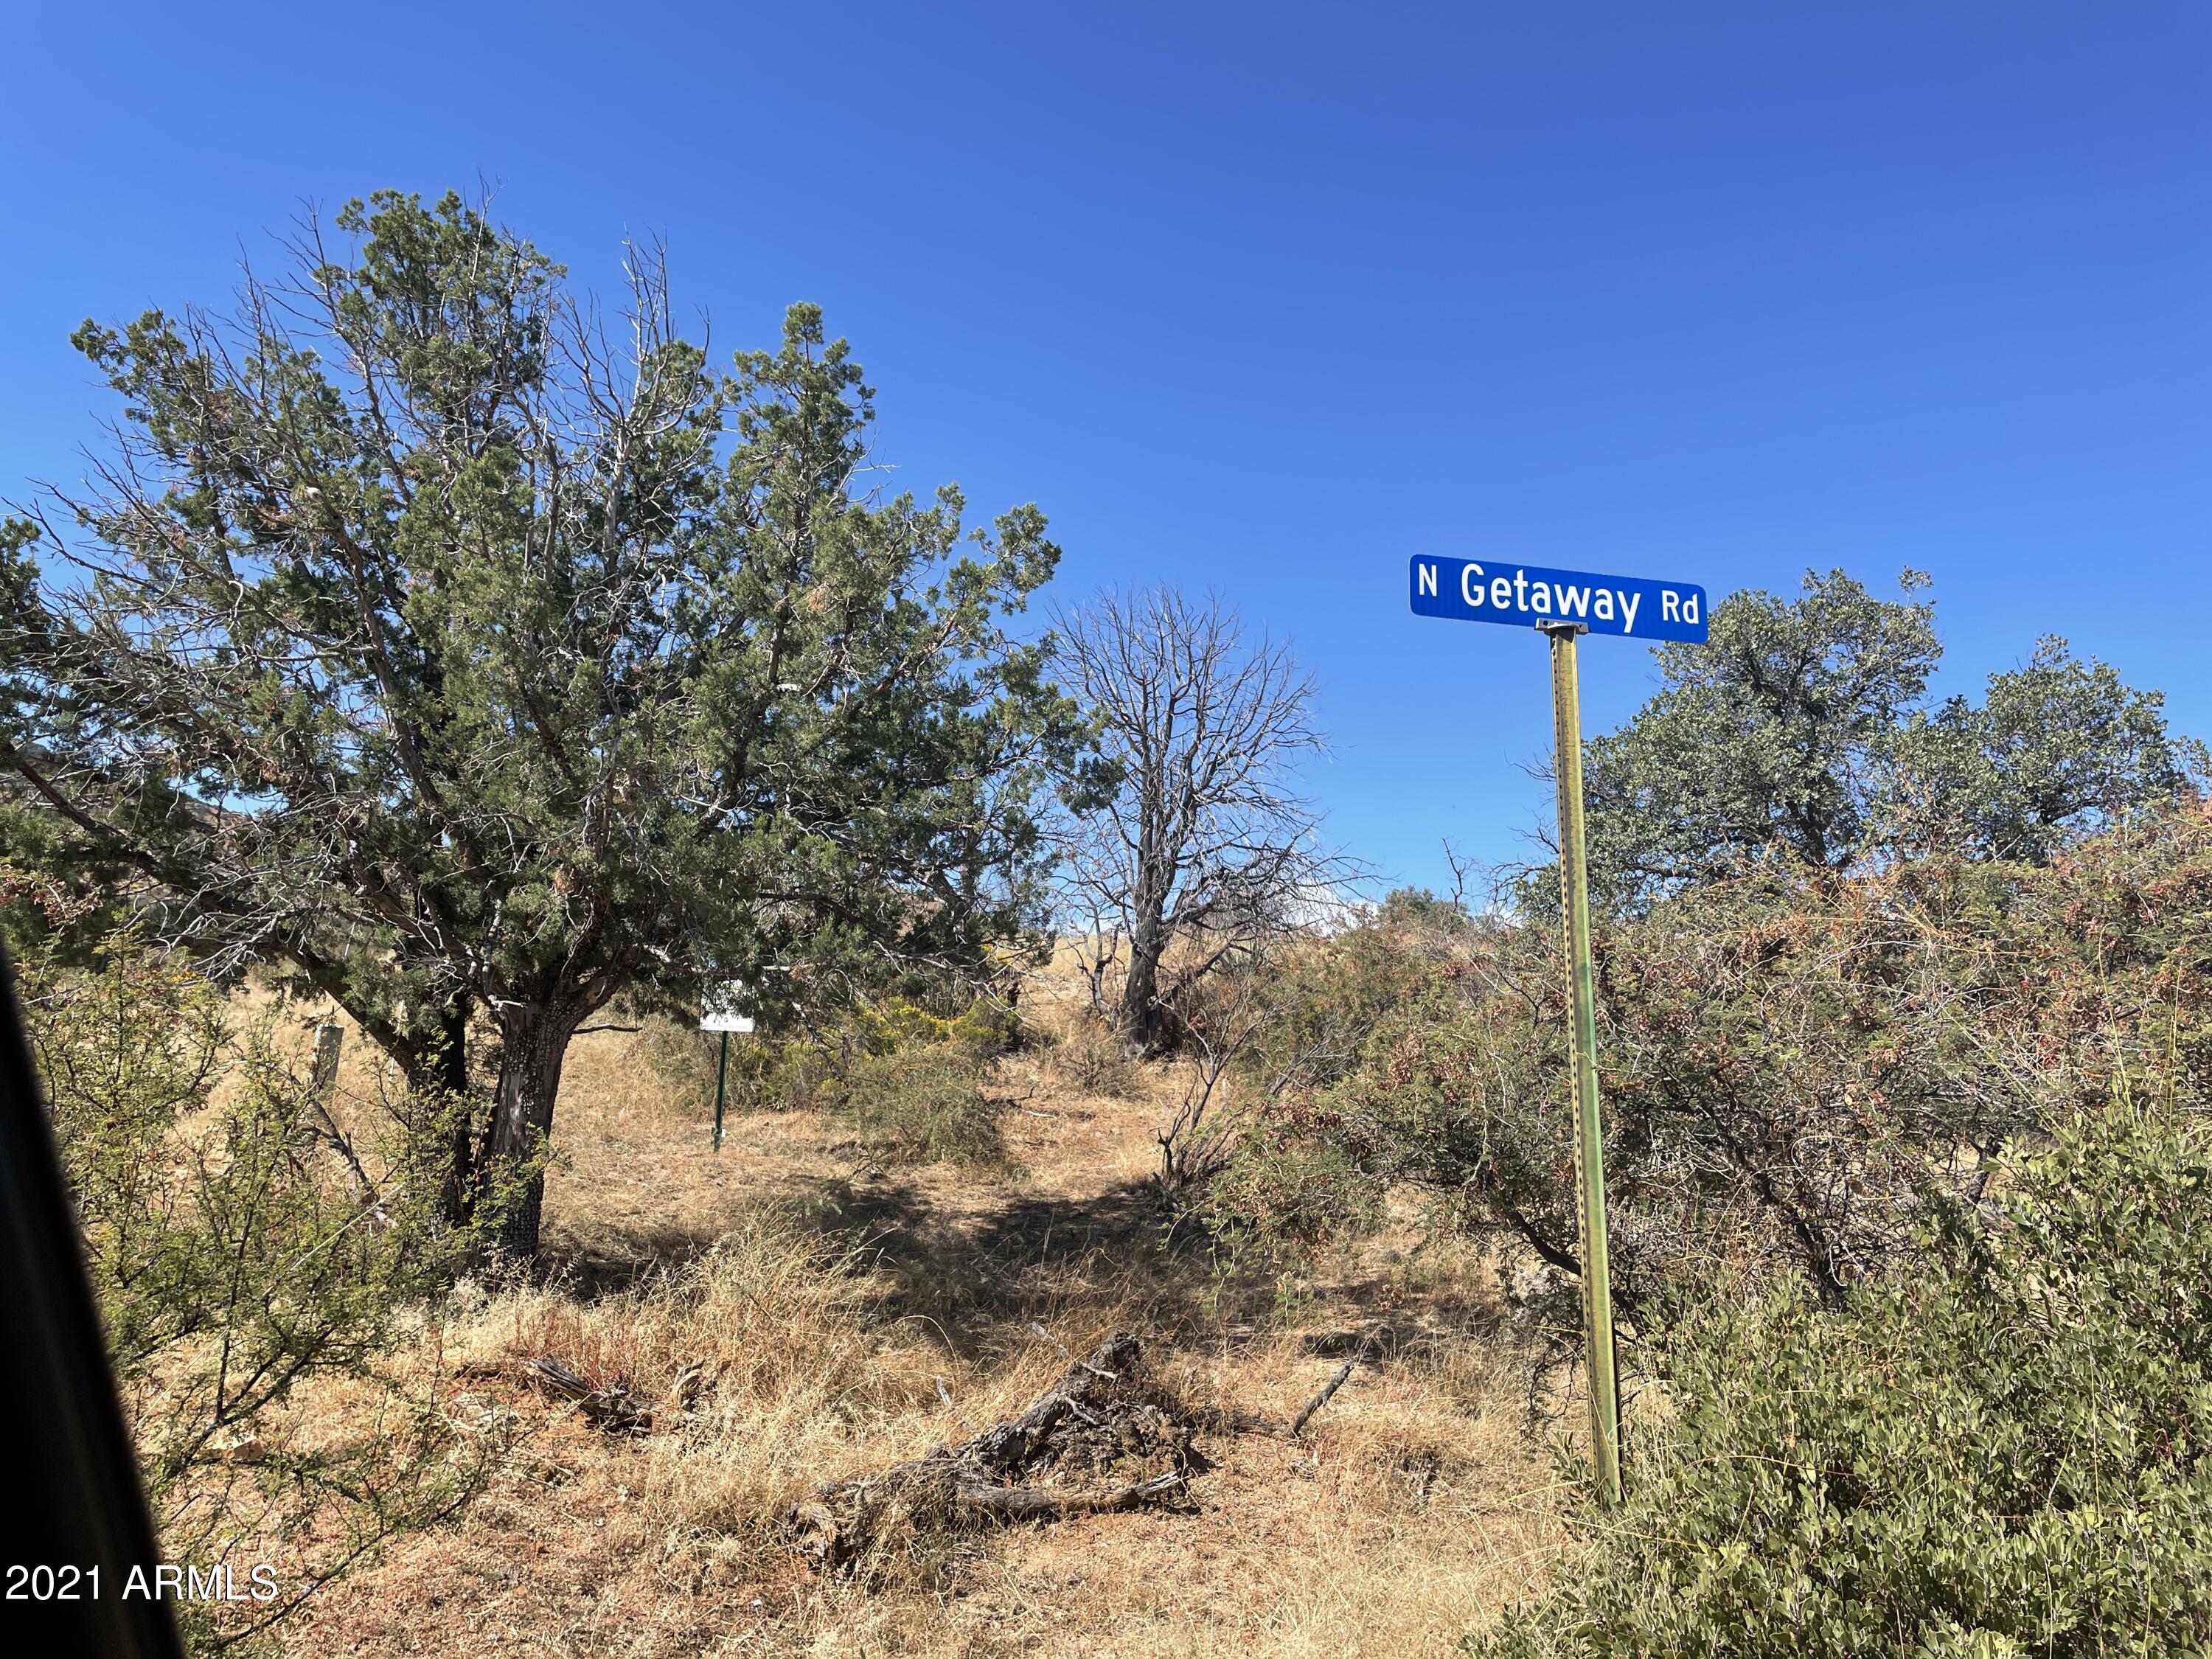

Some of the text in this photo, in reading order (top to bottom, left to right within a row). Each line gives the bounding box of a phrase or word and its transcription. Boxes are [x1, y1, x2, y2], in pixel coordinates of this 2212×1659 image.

[1418, 563, 1700, 633] N Getaway Rd
